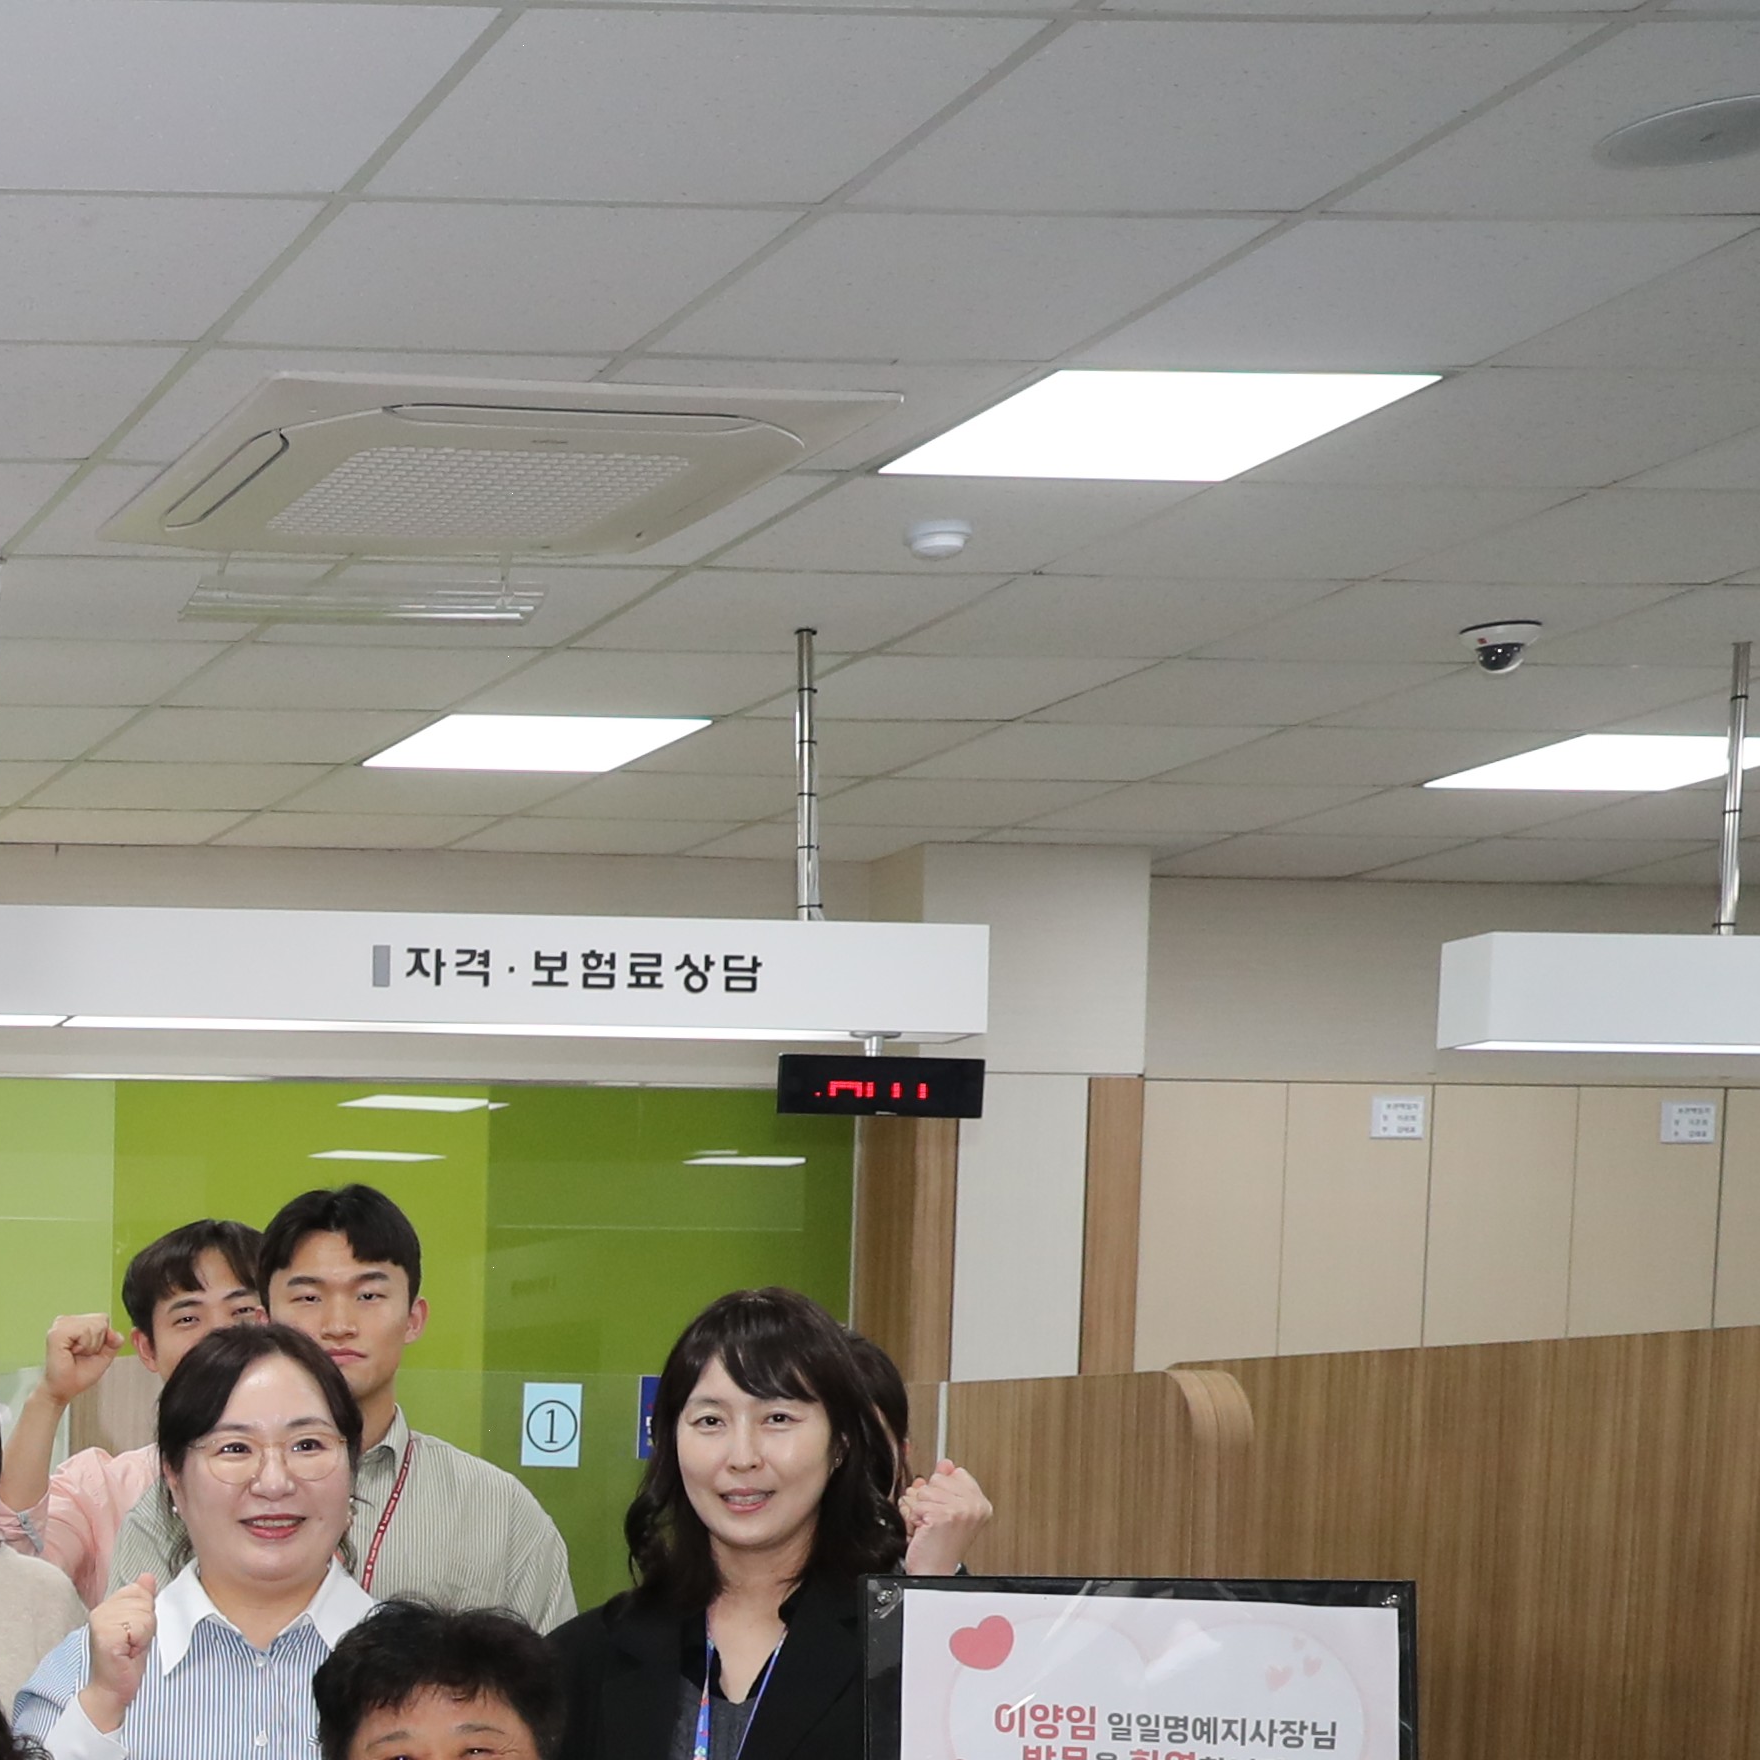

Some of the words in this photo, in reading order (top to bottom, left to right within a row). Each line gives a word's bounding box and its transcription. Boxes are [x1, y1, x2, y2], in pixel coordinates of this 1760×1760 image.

[405, 946, 491, 988] 자격
[993, 1702, 1097, 1742] 이양임
[1106, 1710, 1338, 1751] 일일명예지사장님
